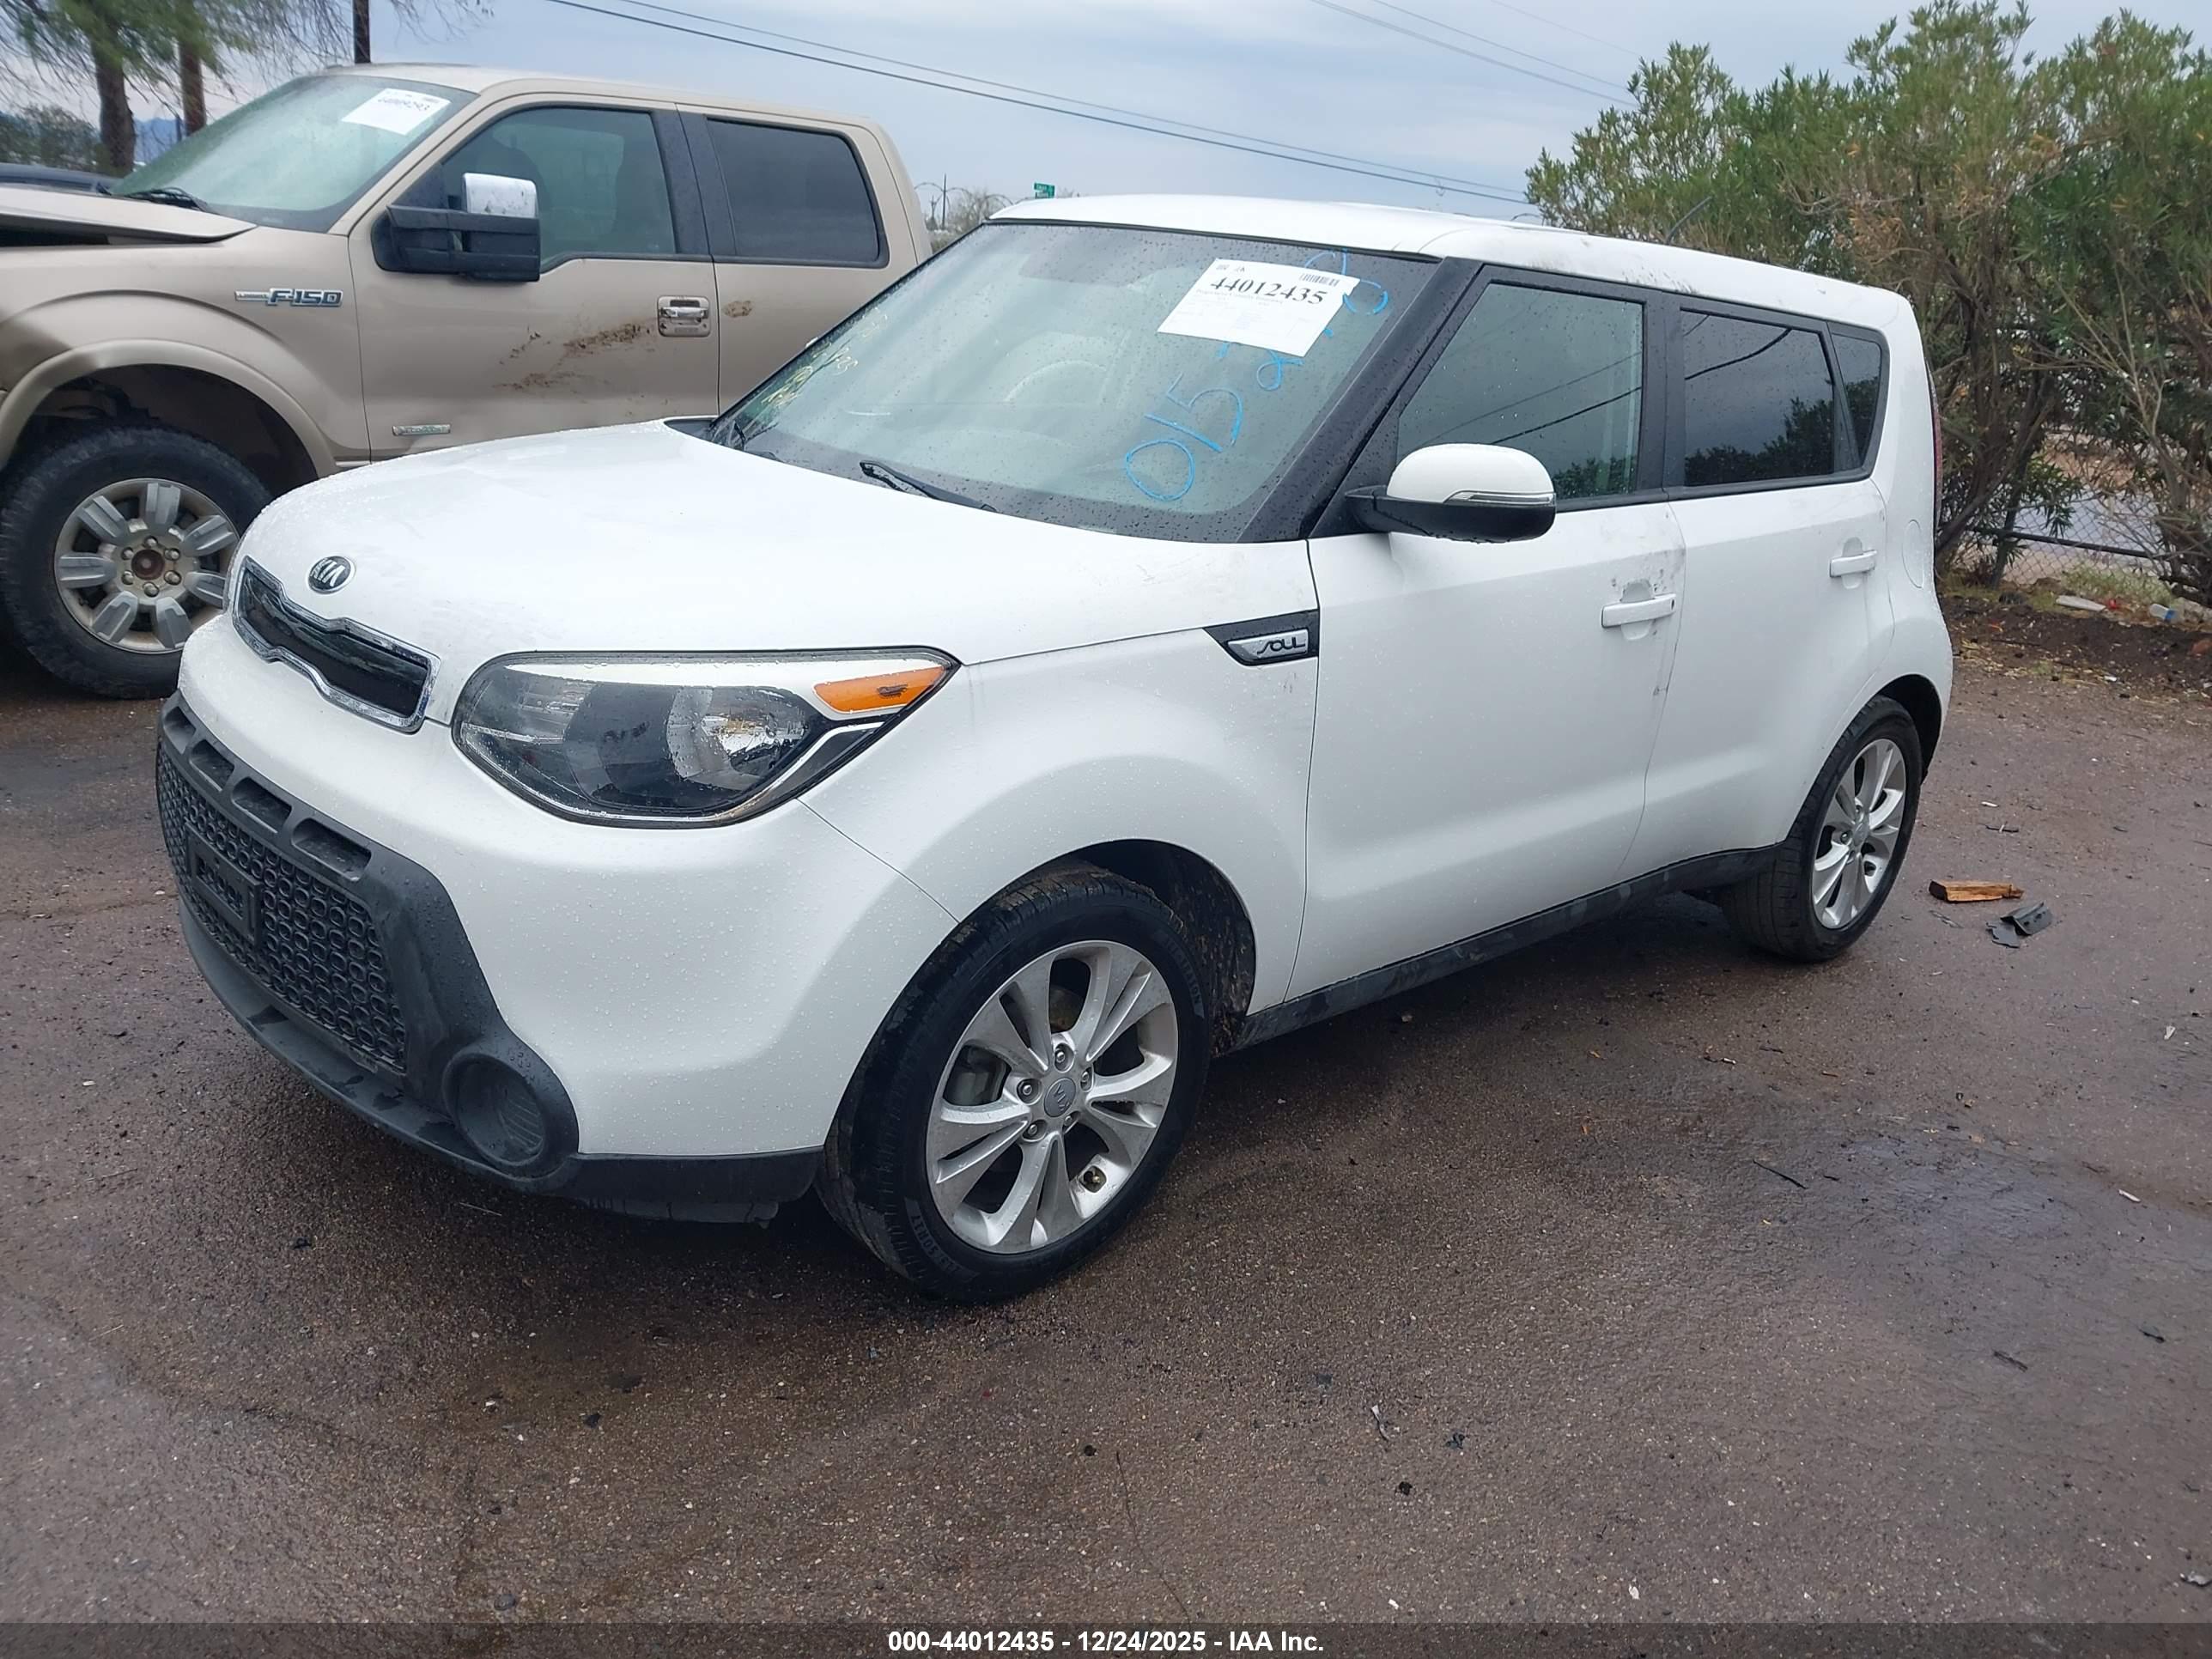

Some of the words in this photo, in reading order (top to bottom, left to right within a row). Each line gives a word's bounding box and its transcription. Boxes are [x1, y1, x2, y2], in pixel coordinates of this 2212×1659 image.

[267, 288, 343, 307] F-150
[1209, 276, 1328, 305] 44012435
[310, 557, 345, 587] KIA
[1256, 636, 1306, 655] SOUL
